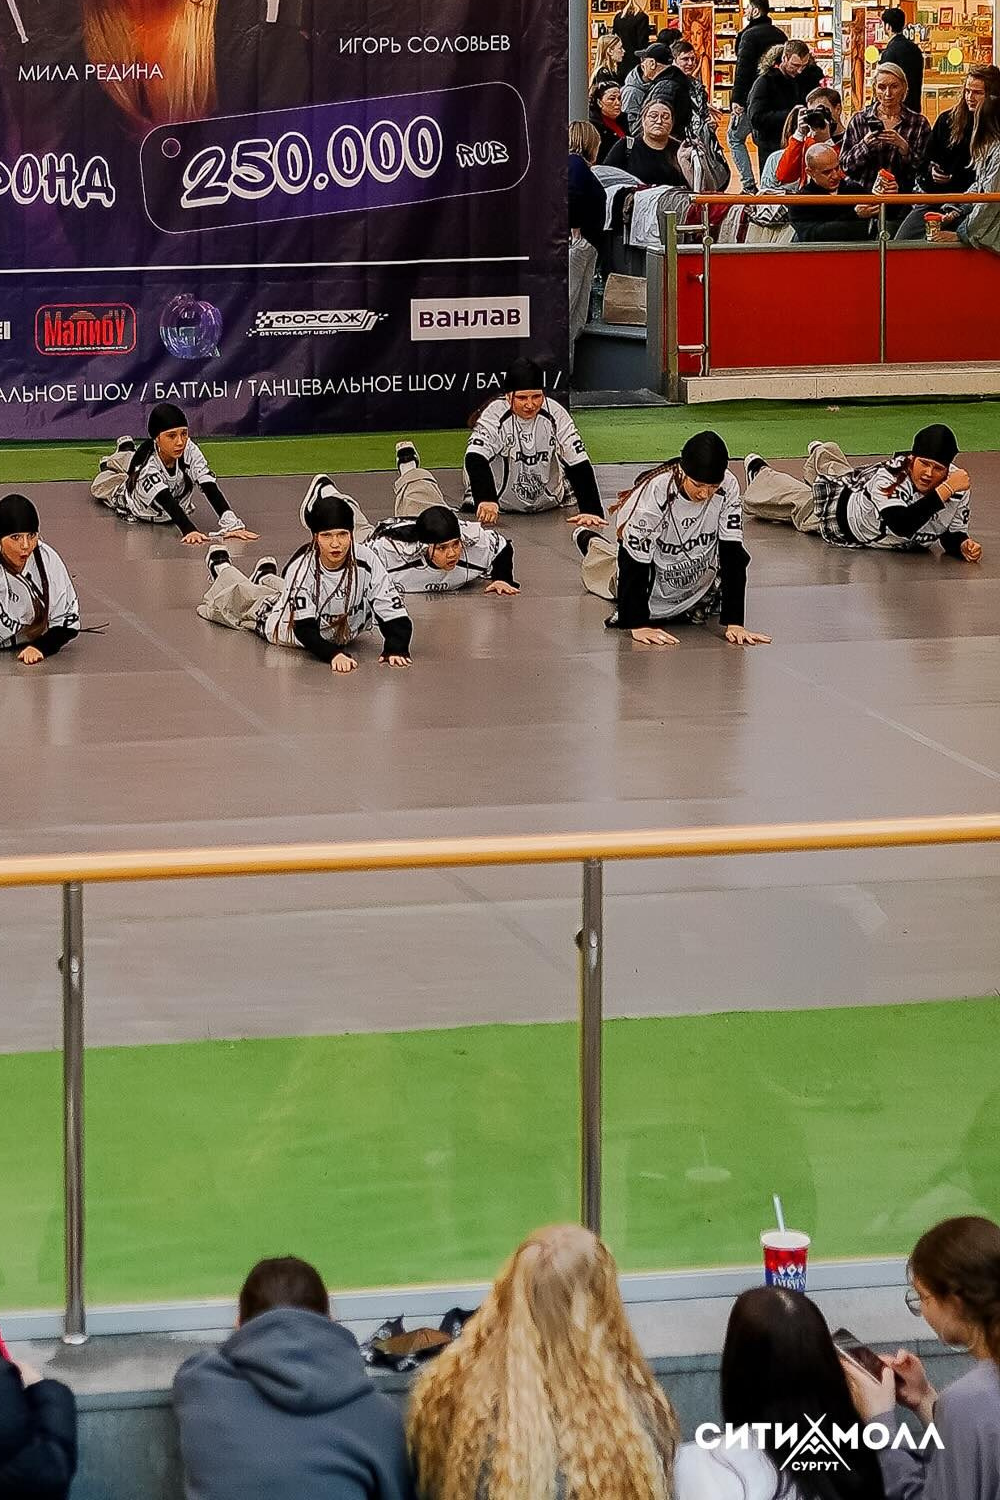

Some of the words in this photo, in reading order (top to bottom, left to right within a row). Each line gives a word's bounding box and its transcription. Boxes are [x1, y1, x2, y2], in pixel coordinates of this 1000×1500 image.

[340, 37, 401, 53] ИГОРЬ
[408, 35, 510, 53] СОЛОВЬЕВ
[19, 65, 78, 81] МИЛА
[84, 62, 165, 84] РЕДИНА
[180, 114, 443, 208] 250.000
[456, 141, 509, 167] RUB
[275, 312, 361, 324] ФОРСАЖ
[420, 306, 521, 328] ванлав
[84, 384, 133, 400] ШОУ
[155, 381, 227, 398] БАТТЛЫ
[248, 376, 402, 397] ТАНЦЕВАЛЬНОЕ
[409, 374, 456, 391] ШОУ
[141, 473, 160, 493] 20
